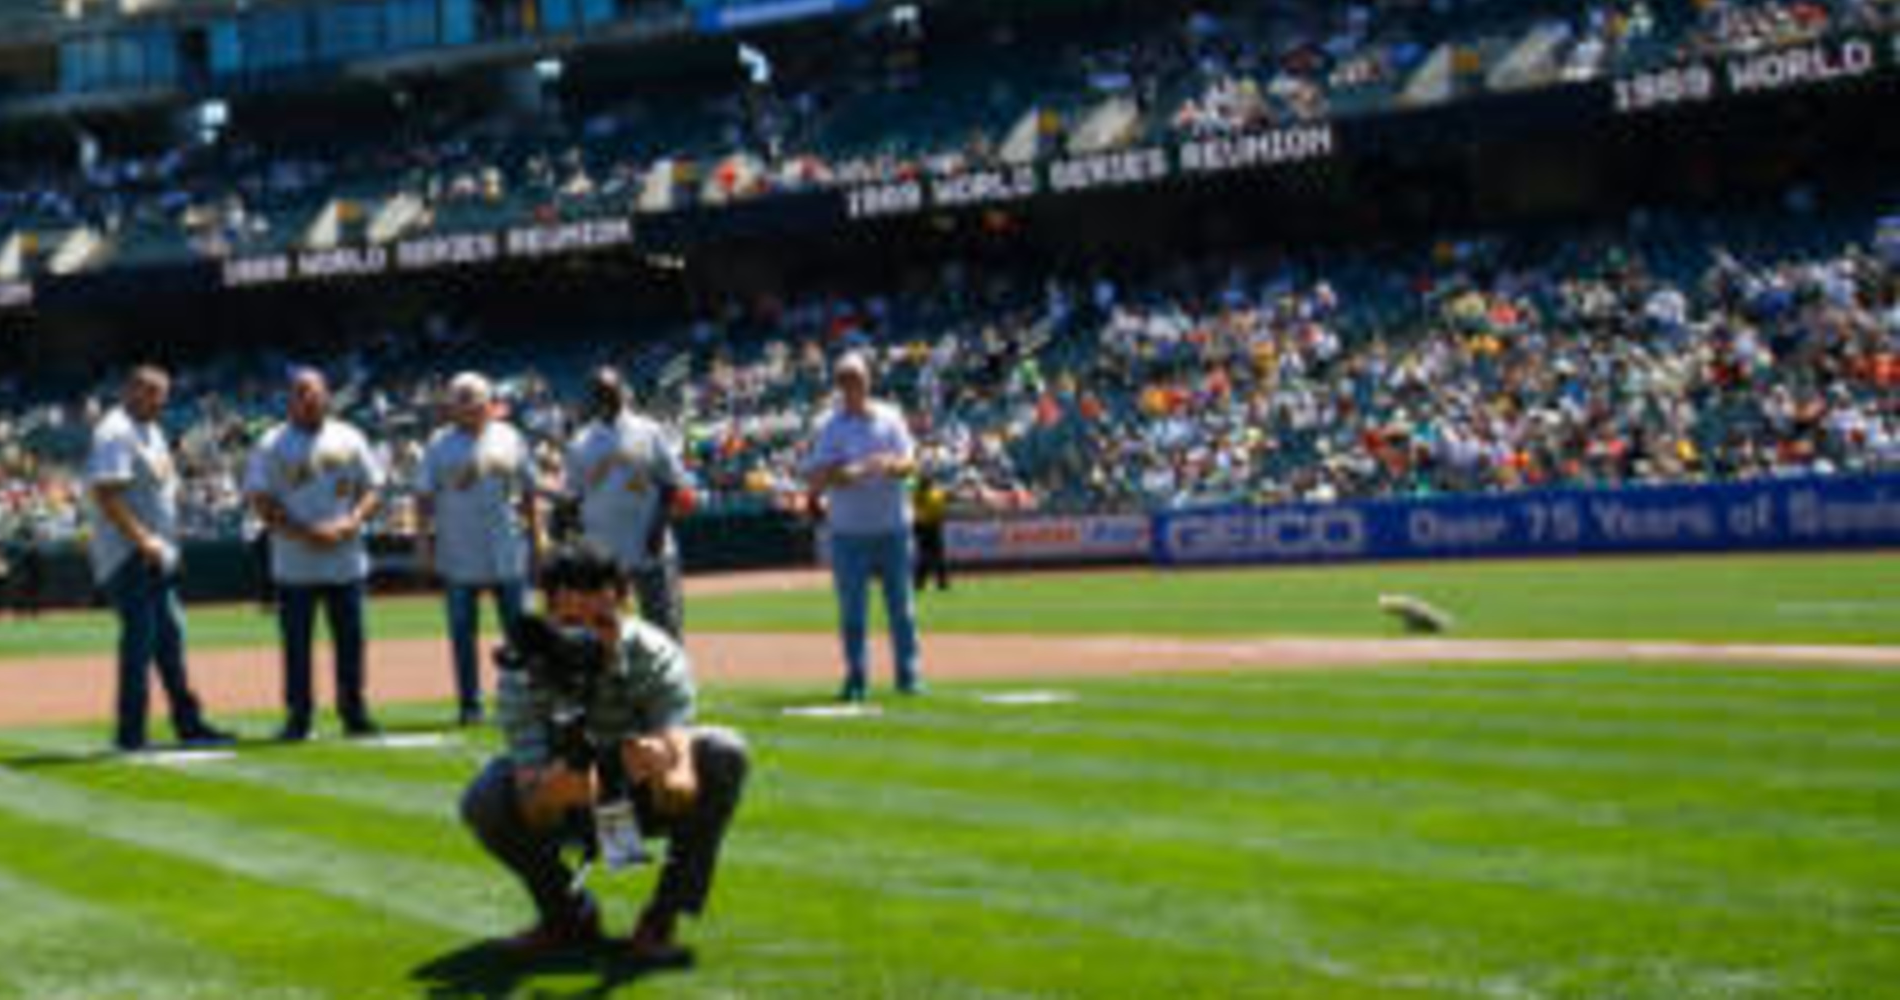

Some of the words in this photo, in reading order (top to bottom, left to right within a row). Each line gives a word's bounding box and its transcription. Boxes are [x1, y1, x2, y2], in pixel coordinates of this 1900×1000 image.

[1614, 64, 1712, 113] 1989
[1726, 39, 1874, 93] WORLD
[931, 171, 1034, 204] WORLD
[1048, 147, 1168, 191] SERIES
[1179, 126, 1332, 171] REUNION
[1167, 510, 1366, 556] GEICO
[1410, 508, 1502, 544] Over
[1528, 500, 1580, 543] 75
[1591, 495, 1717, 541] Years
[1729, 493, 1770, 536] of
